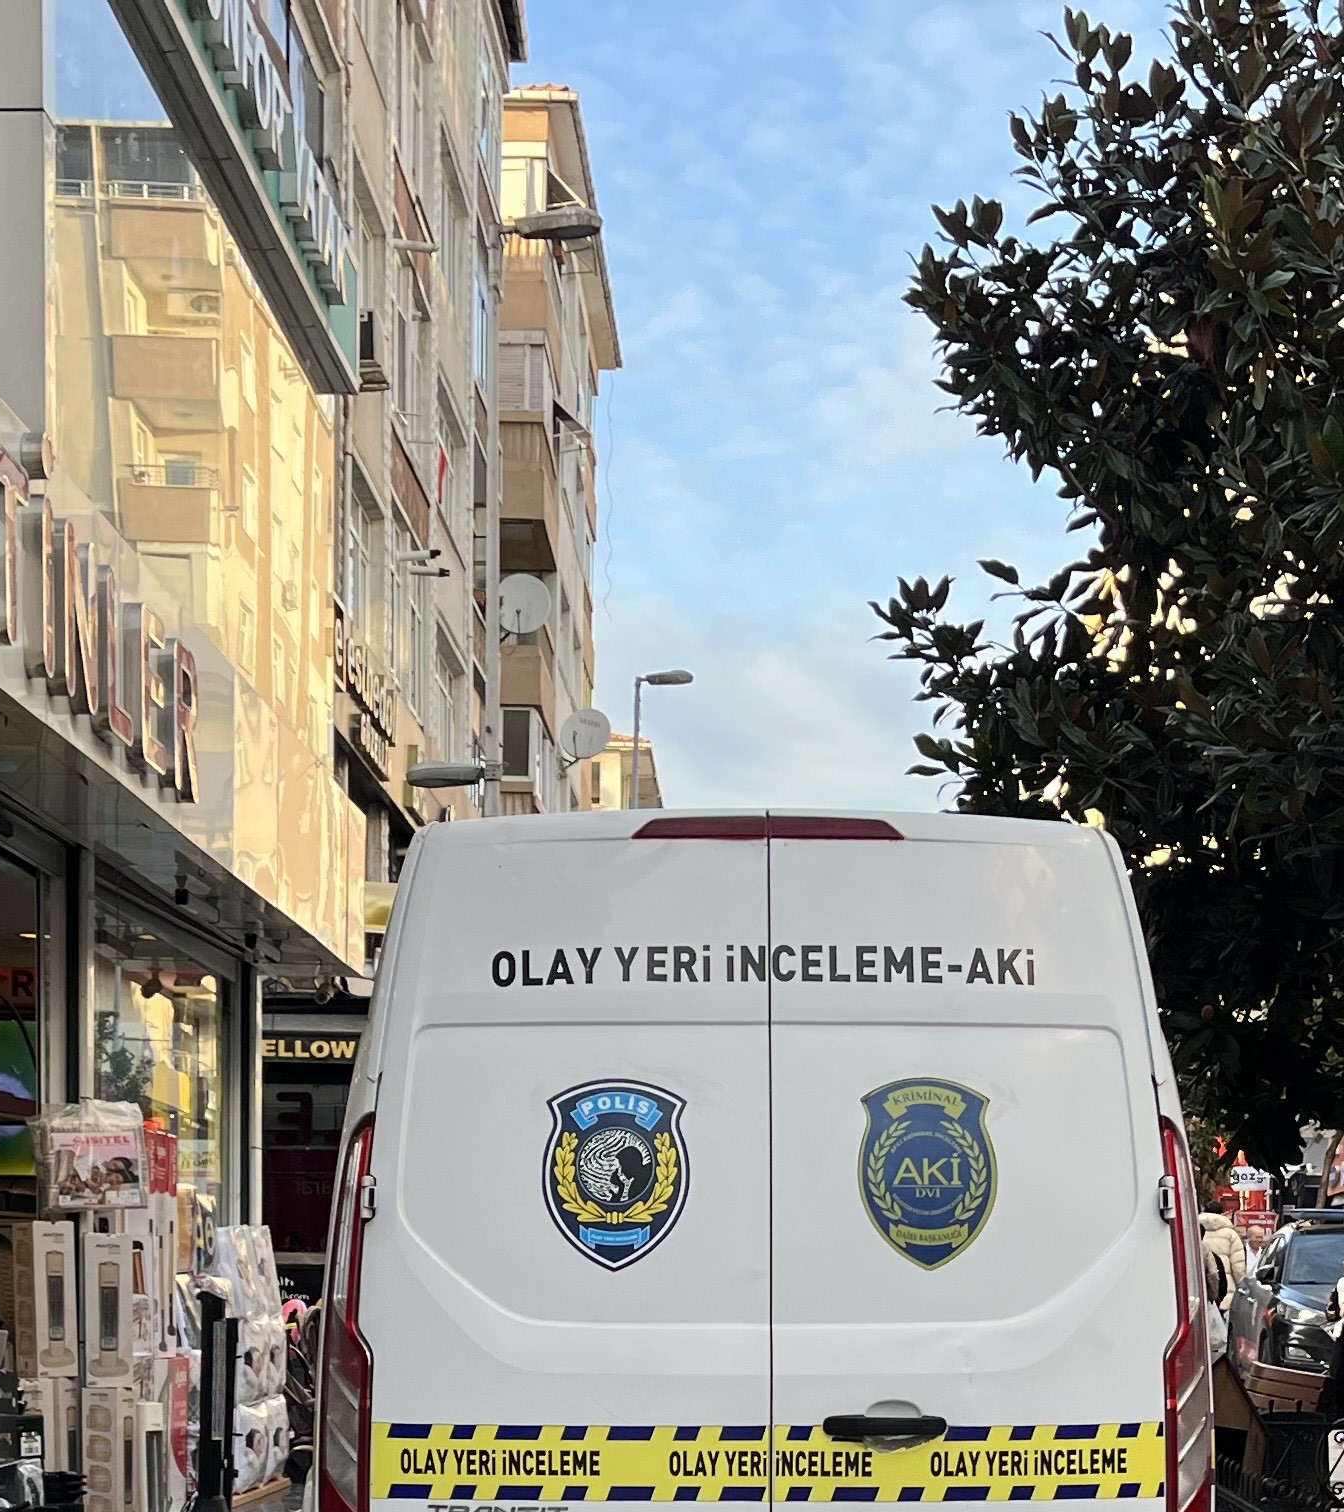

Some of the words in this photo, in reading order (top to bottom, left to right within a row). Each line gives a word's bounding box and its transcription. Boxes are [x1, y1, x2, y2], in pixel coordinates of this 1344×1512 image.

[491, 947, 603, 987] OLAY
[580, 1095, 650, 1116] POLİS
[892, 1089, 960, 1107] KRİMİNAL
[892, 1152, 962, 1186] AKİ
[400, 1447, 446, 1475] OLAY
[668, 1450, 720, 1477] OLAY
[930, 1451, 980, 1477] OLAY
